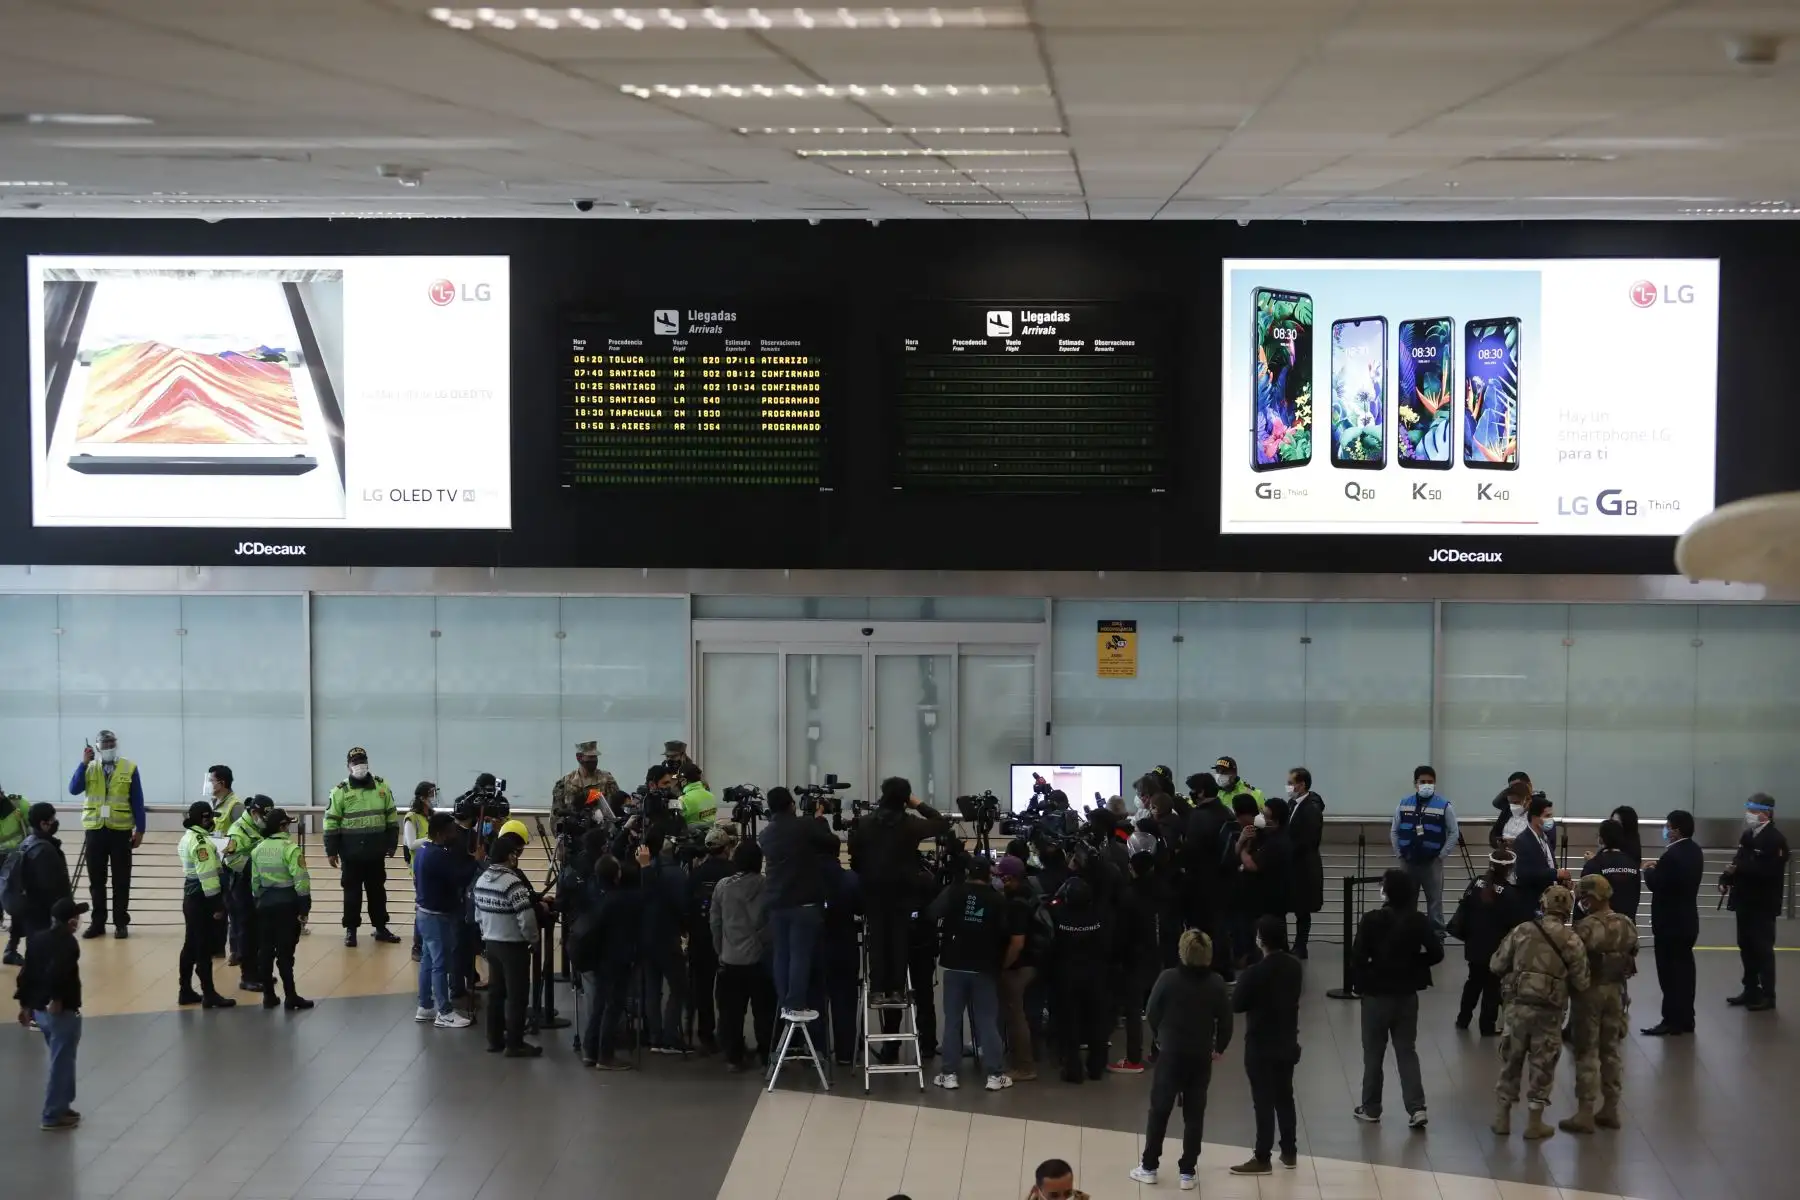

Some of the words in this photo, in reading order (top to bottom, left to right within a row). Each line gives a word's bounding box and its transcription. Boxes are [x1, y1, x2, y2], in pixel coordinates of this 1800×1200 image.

[462, 283, 491, 302] LG
[1664, 284, 1694, 304] LG
[688, 310, 737, 322] Llegadas
[1021, 310, 1070, 324] Llegadas
[688, 324, 723, 334] Arrivals
[1022, 326, 1056, 335] Arrivals
[1274, 328, 1298, 340] 08:30
[1412, 346, 1436, 358] 08:30
[1478, 348, 1503, 360] 08:30
[1559, 408, 1586, 424] Hay
[1591, 412, 1610, 422] un
[1558, 428, 1647, 443] smartphone
[1558, 449, 1592, 462] para
[1597, 446, 1608, 460] ti
[362, 489, 383, 502] LG
[390, 489, 432, 502] OLED
[436, 489, 458, 502] TV
[1344, 482, 1376, 501] Q60
[1412, 482, 1442, 500] K50
[1477, 482, 1510, 500] K40
[1558, 496, 1588, 515] LG
[1648, 500, 1680, 510] ThinQ
[234, 542, 306, 555] JCDecaux
[1428, 549, 1502, 562] JCDecaux
[1059, 923, 1100, 932] MIGRACIONES
